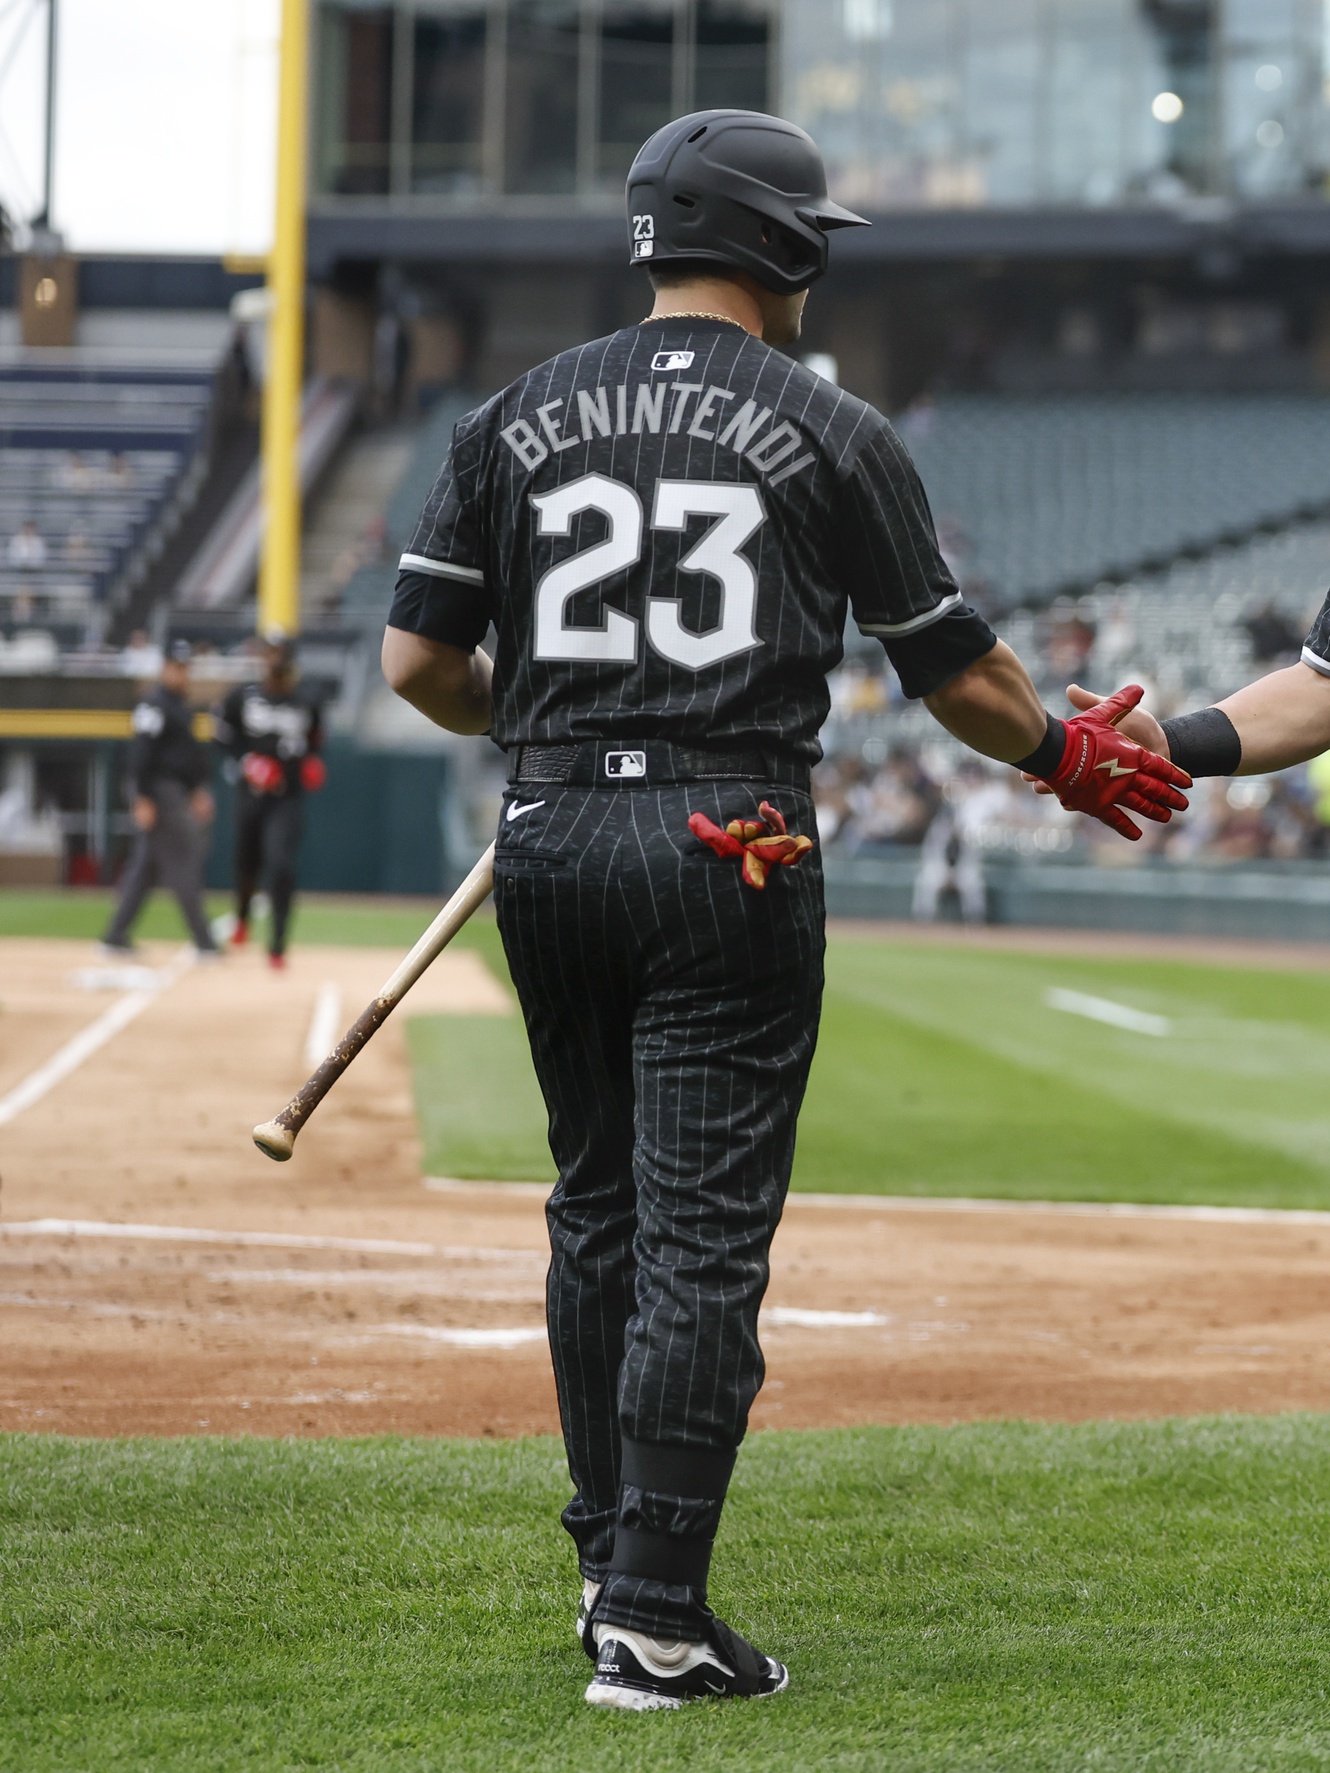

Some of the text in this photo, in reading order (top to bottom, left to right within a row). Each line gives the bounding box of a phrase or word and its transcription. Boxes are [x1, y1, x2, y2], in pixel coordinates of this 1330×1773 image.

[633, 214, 655, 240] 23
[500, 382, 816, 487] BENINTENDI
[527, 470, 768, 672] 23
